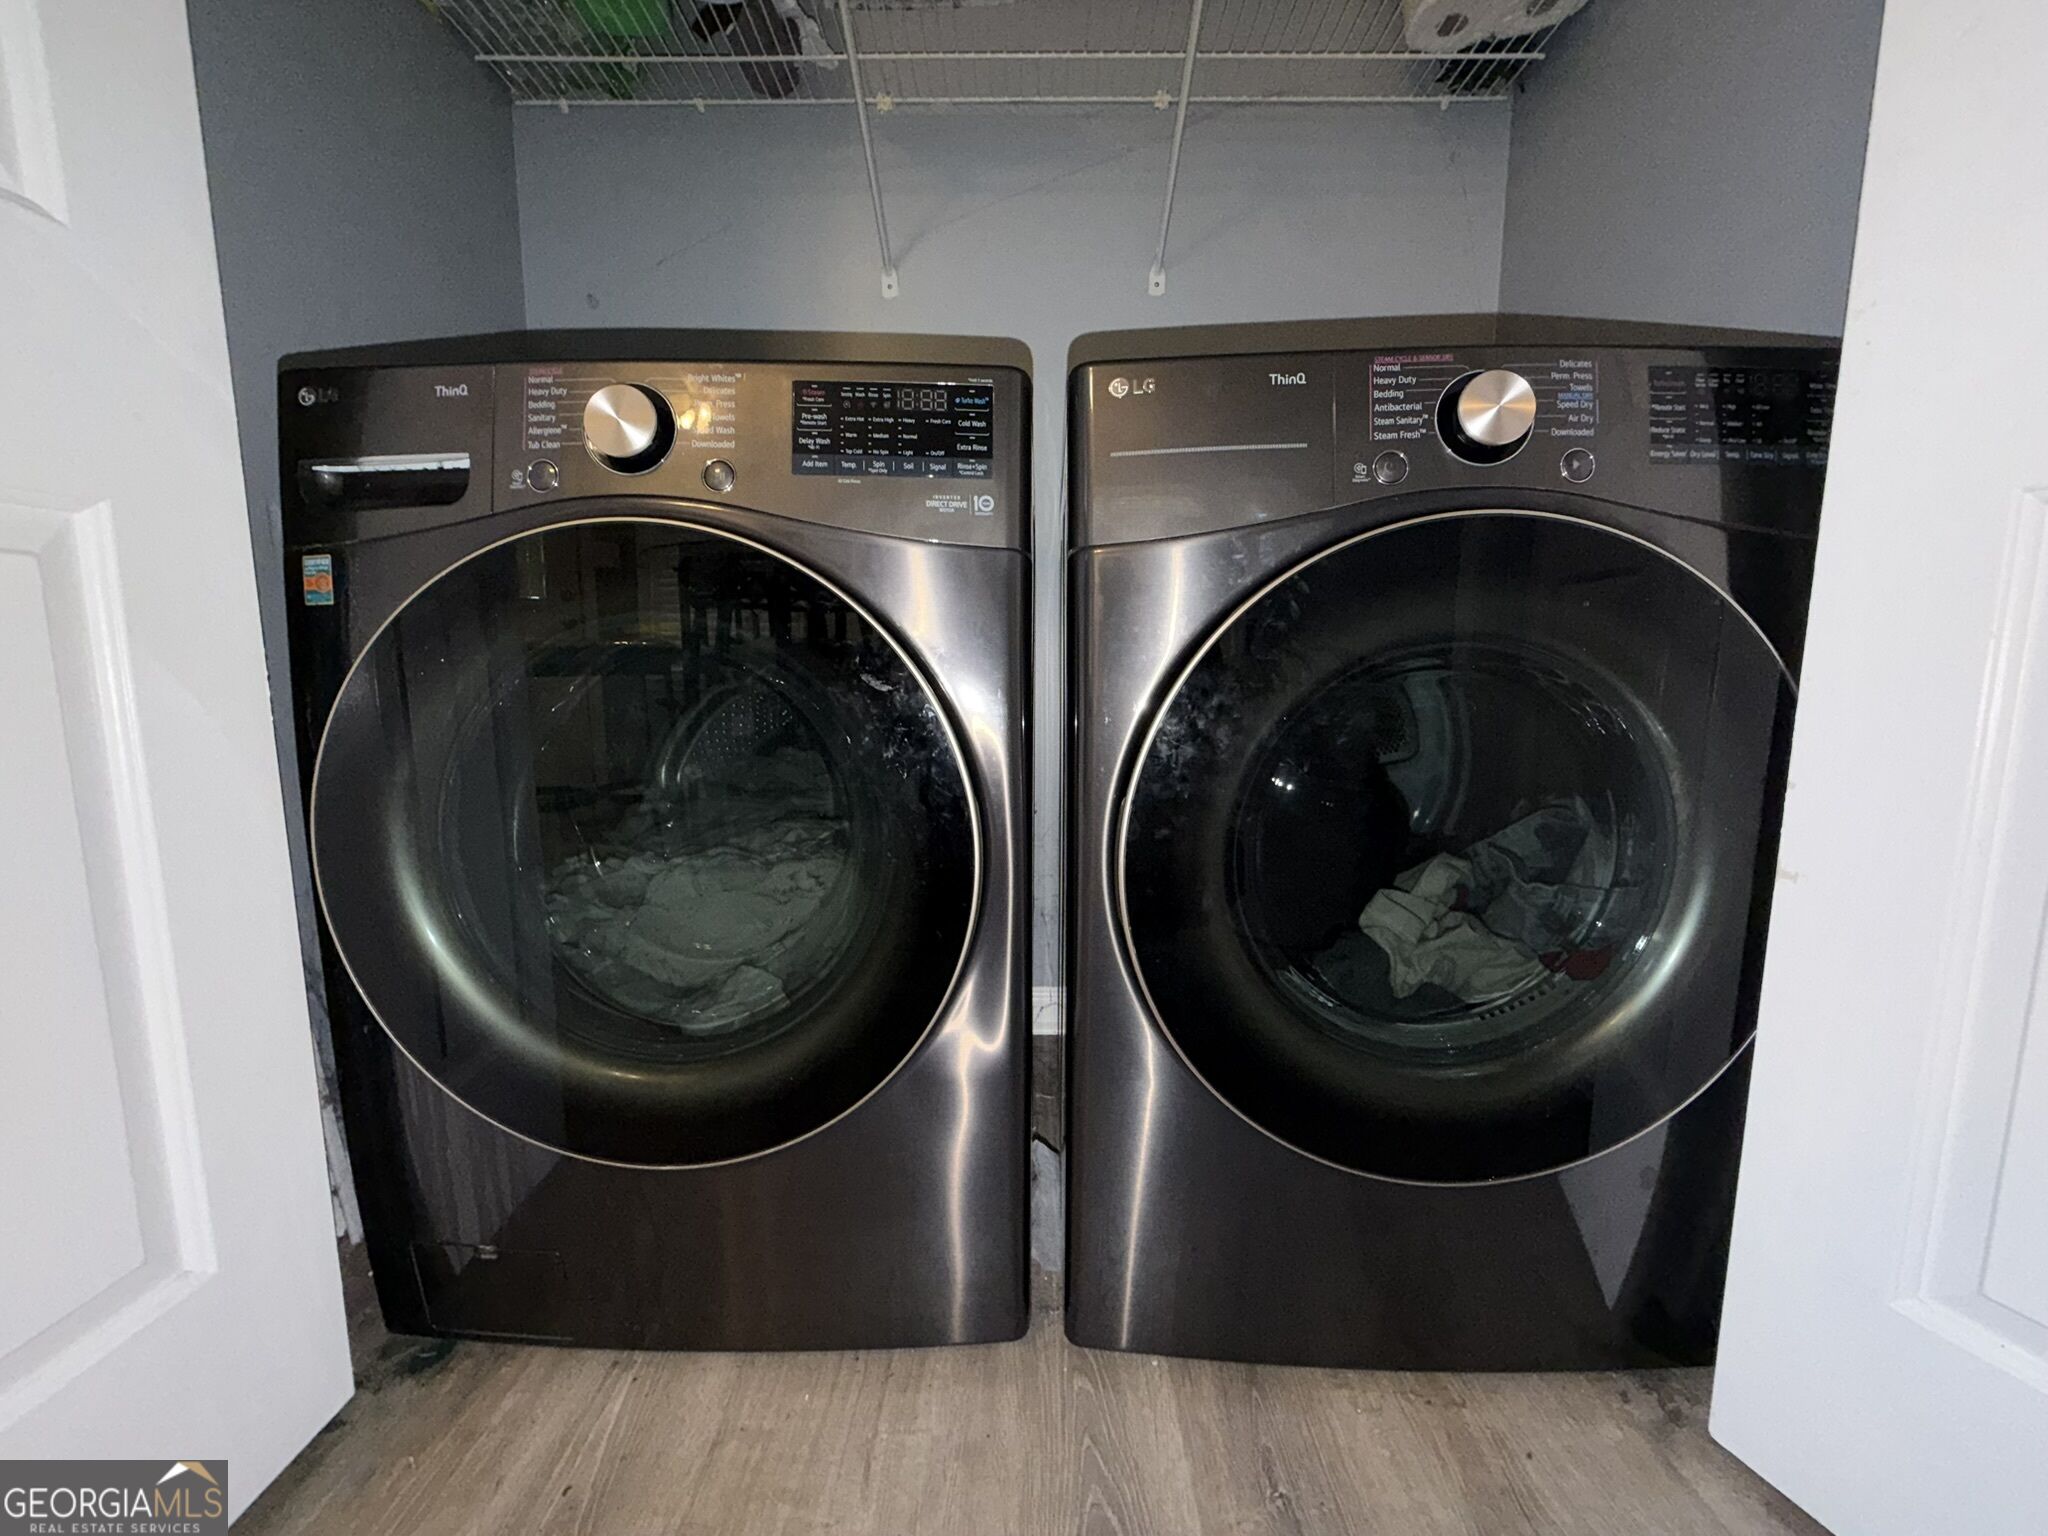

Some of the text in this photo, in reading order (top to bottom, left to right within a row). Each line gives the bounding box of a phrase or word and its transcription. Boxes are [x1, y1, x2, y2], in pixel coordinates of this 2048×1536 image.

[1373, 364, 1401, 372] Normal
[1559, 360, 1593, 368] Delicates
[528, 376, 554, 384] Normal
[1269, 372, 1307, 385] ThinQ
[1373, 375, 1417, 386] Heavy Duty
[1573, 372, 1593, 380] Press
[435, 384, 468, 397] ThinQ
[528, 386, 568, 397] Heavy Duty
[703, 386, 736, 395] Delicates
[1133, 379, 1155, 395] LG
[1569, 383, 1593, 391] Towels
[1373, 389, 1404, 399] Bedding
[528, 401, 556, 410] Bedding
[716, 400, 736, 409] Press
[1374, 402, 1423, 412] Antibacterial
[1556, 401, 1593, 410] Speed Dry
[528, 414, 556, 423] Sanitary
[1373, 417, 1395, 426] Steam
[1568, 414, 1594, 424] Air Dry
[957, 419, 987, 428] Cold Wash
[715, 426, 736, 435] Wash
[1551, 427, 1595, 437] Downloaded
[1373, 431, 1398, 440] Steam
[528, 440, 561, 449] Tub Clean
[691, 440, 736, 449] Downloaded
[798, 437, 831, 446] Delay Wash
[972, 443, 988, 451] Rinse
[841, 461, 857, 469] Temp.
[903, 462, 914, 470] Soil
[929, 463, 947, 471] Signal
